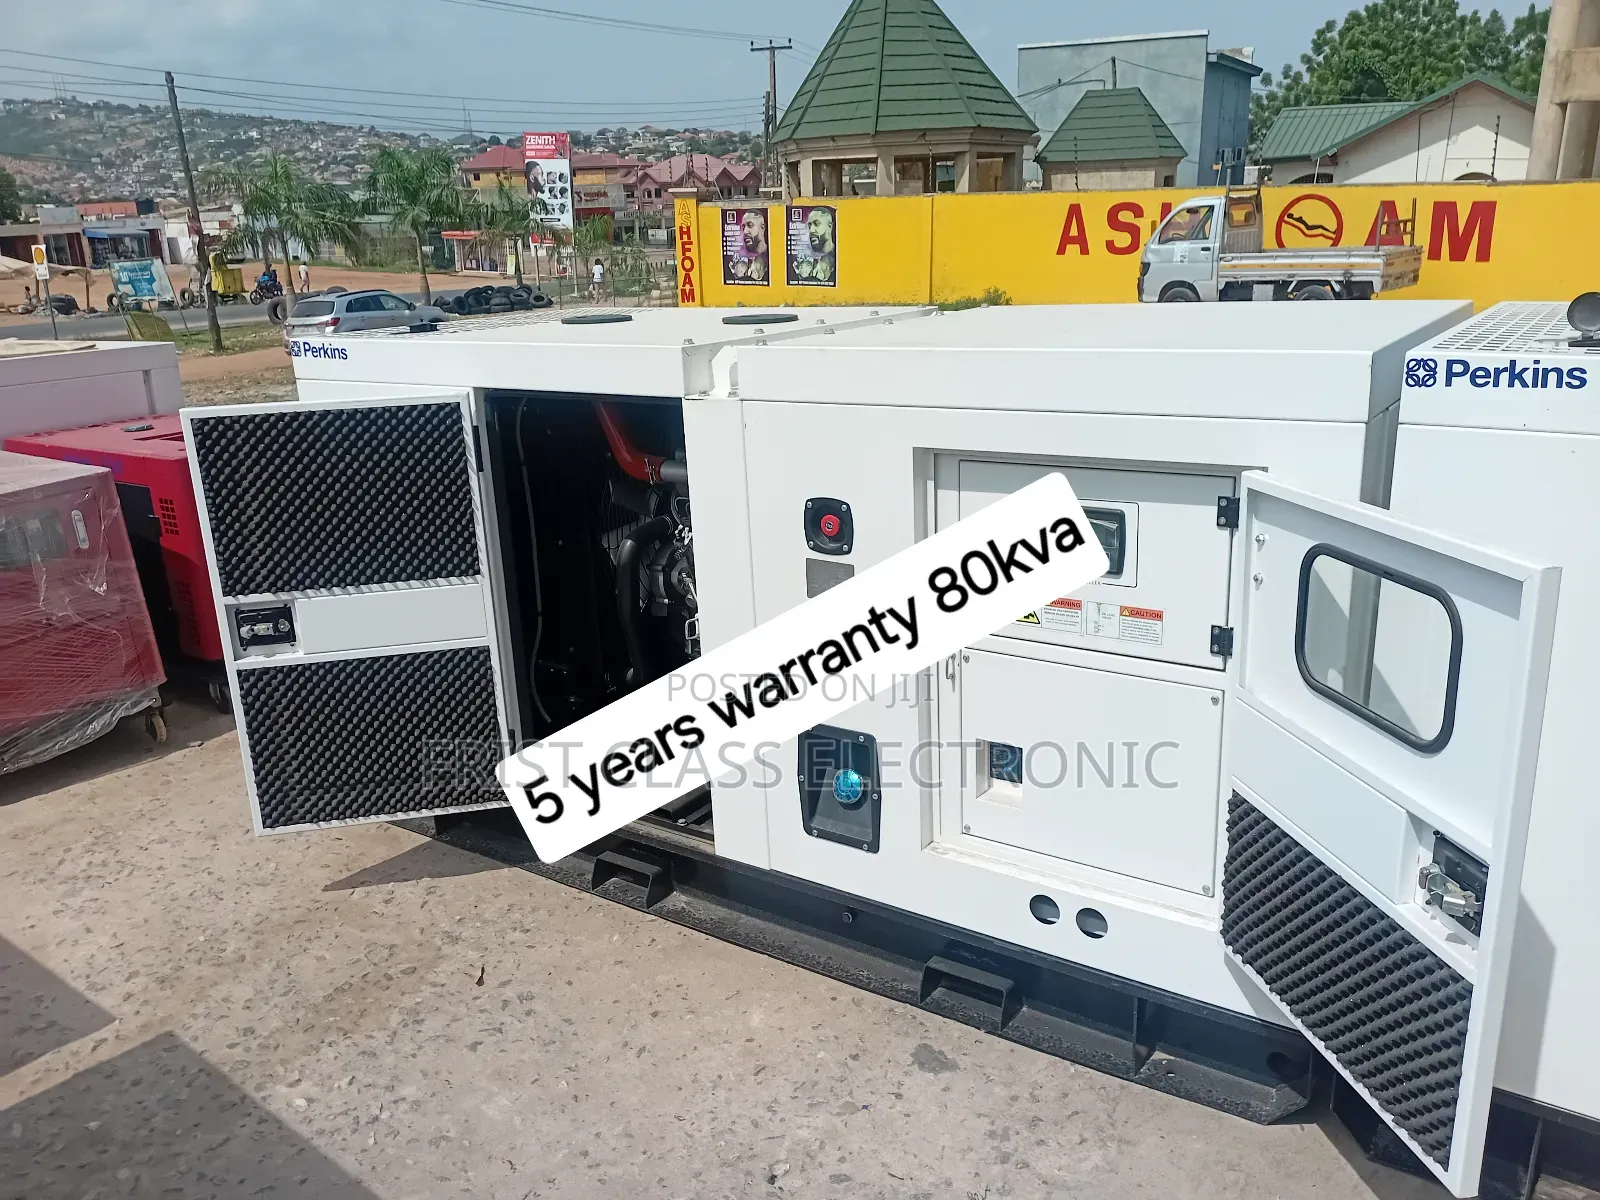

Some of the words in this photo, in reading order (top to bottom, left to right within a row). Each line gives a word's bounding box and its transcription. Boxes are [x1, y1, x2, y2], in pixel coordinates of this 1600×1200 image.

[526, 135, 556, 145] ZENITH
[678, 199, 696, 303] ASHFOAM
[303, 341, 348, 360] Perkins
[1444, 359, 1588, 390] Perkins
[1130, 609, 1162, 620] CAUTION
